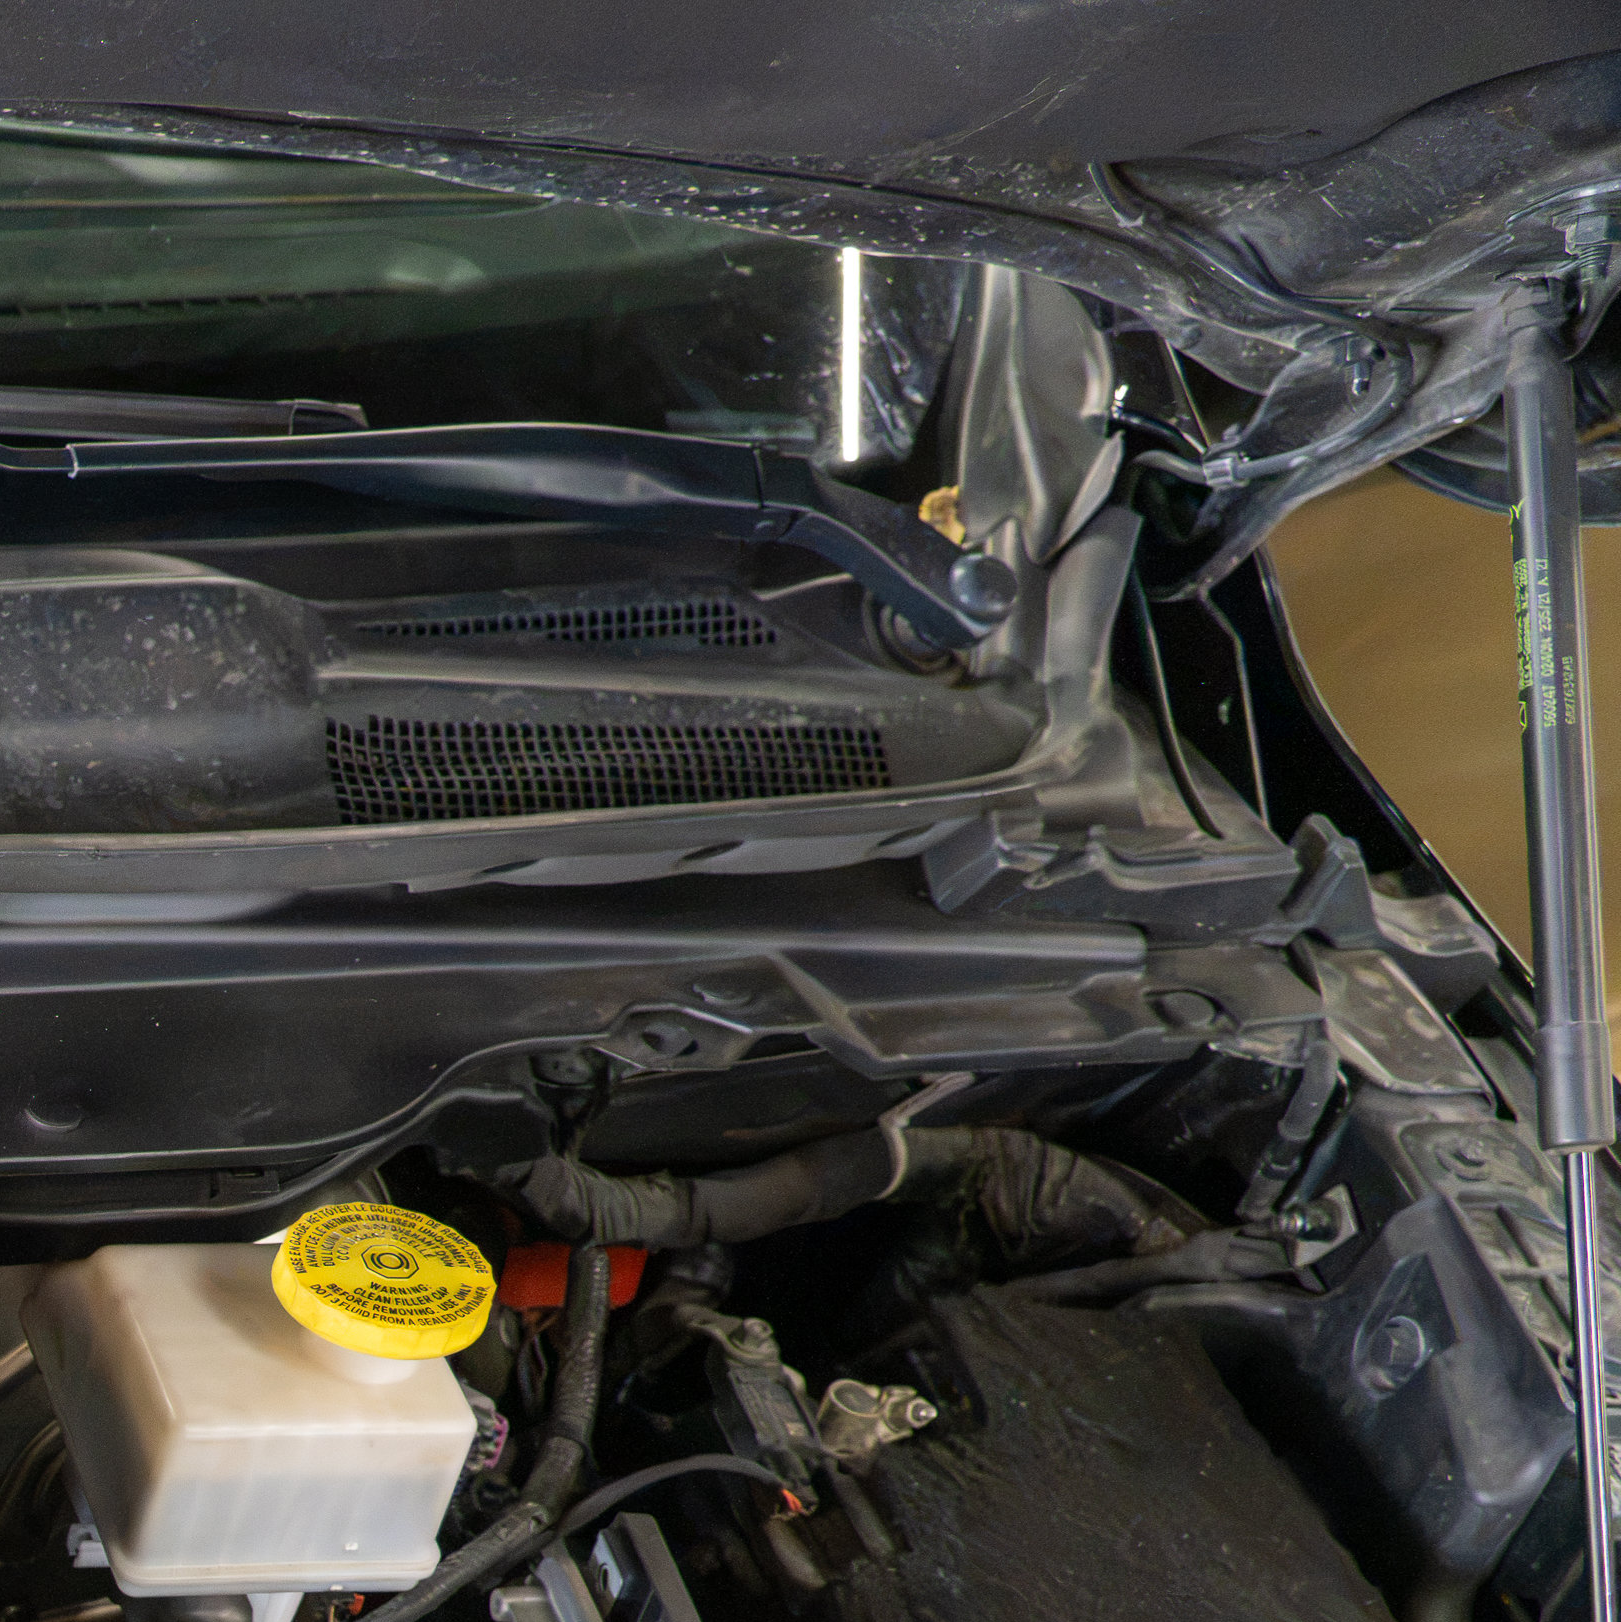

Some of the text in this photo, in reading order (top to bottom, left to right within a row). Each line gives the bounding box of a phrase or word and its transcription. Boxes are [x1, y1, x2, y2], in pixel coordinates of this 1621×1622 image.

[426, 1219, 442, 1229] DE
[309, 1284, 334, 1298] DOT
[338, 1301, 370, 1318] FLUID
[372, 1313, 406, 1325] FROM
[408, 1318, 416, 1326] A
[418, 1313, 457, 1326] SEALED
[326, 1283, 370, 1308] BEFORE
[437, 1299, 459, 1311] USE
[453, 1282, 473, 1301] ONLY
[353, 1286, 450, 1306] CLEAN FILLER CAP
